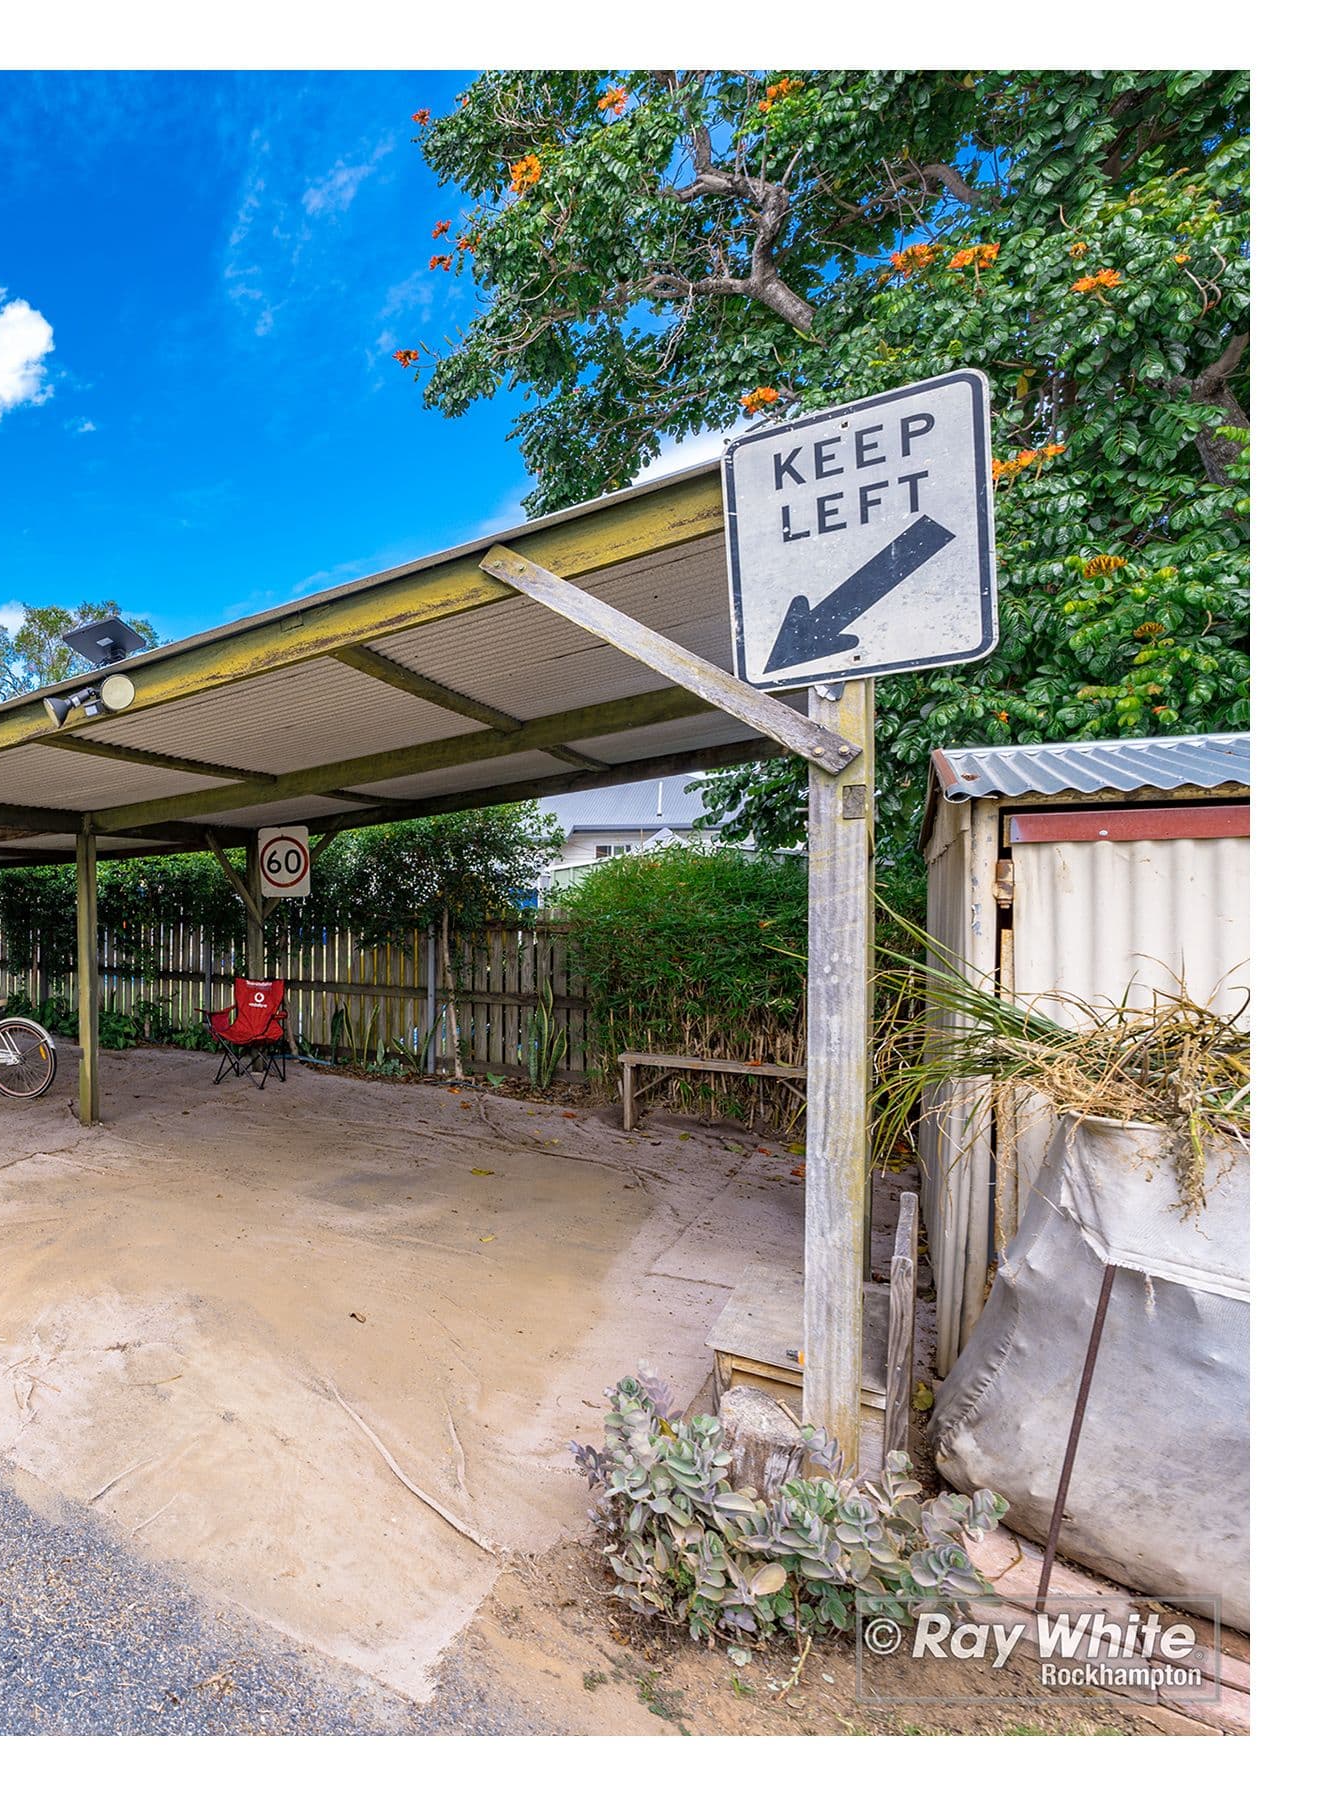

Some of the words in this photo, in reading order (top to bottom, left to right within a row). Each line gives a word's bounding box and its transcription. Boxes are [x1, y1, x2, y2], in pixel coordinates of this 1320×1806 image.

[774, 412, 935, 490] KEEP
[782, 471, 928, 542] LEFT
[267, 849, 301, 874] 60
